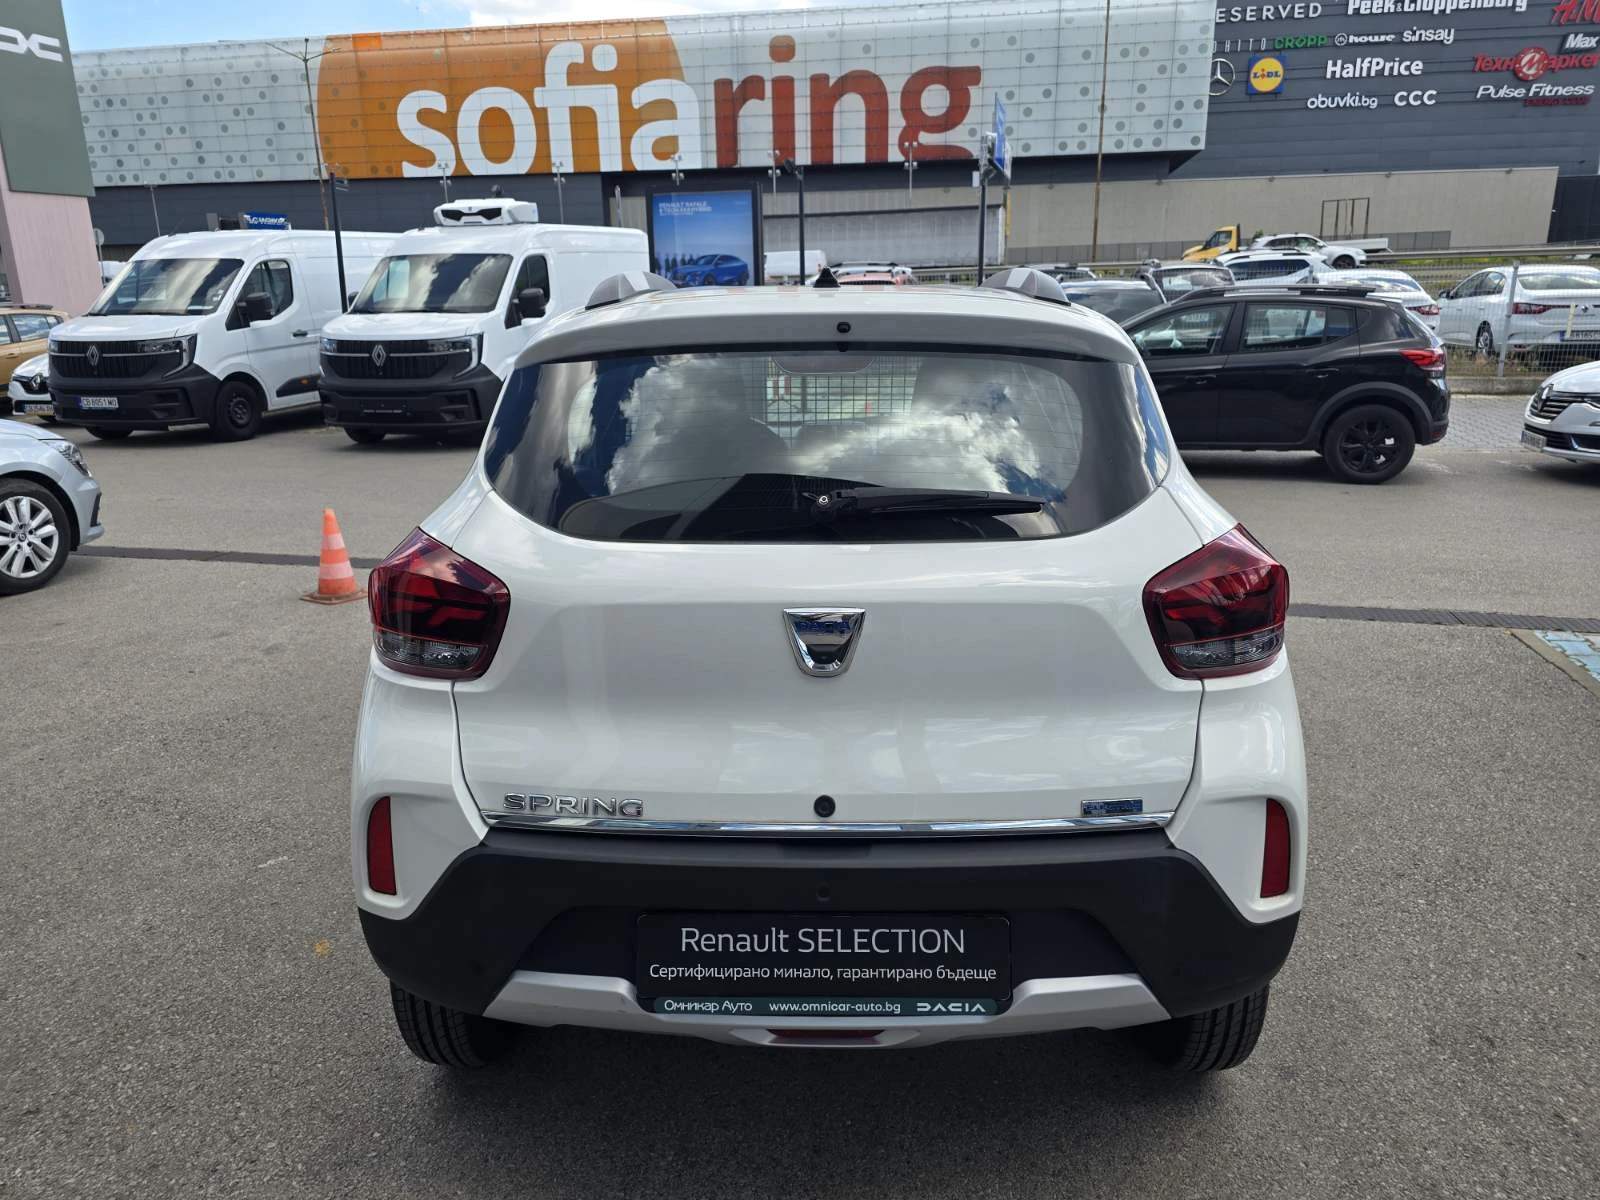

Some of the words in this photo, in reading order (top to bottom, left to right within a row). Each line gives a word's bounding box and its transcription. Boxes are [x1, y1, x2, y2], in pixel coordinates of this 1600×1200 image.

[1274, 34, 1328, 49] CROPP
[1402, 26, 1455, 45] sinsay
[1565, 33, 1599, 49] Max
[1325, 57, 1424, 80] HalfPrice
[1393, 90, 1437, 106] CCC
[1476, 84, 1526, 99] Pulse
[1528, 83, 1595, 97] Fitness
[1307, 92, 1378, 110] obuvki.bg
[503, 793, 643, 817] SPRING
[680, 927, 789, 953] Renault
[797, 928, 965, 953] SELECTION
[650, 963, 770, 981] Сертифицирано
[773, 966, 834, 981] минало,
[837, 967, 936, 982] гарантирано
[936, 966, 997, 982] бъдеще
[664, 1000, 720, 1013] Омникар
[722, 1000, 753, 1014] Ауто
[769, 1001, 901, 1014] www.omnicar-auto.bg
[916, 1002, 986, 1012] DACIA
